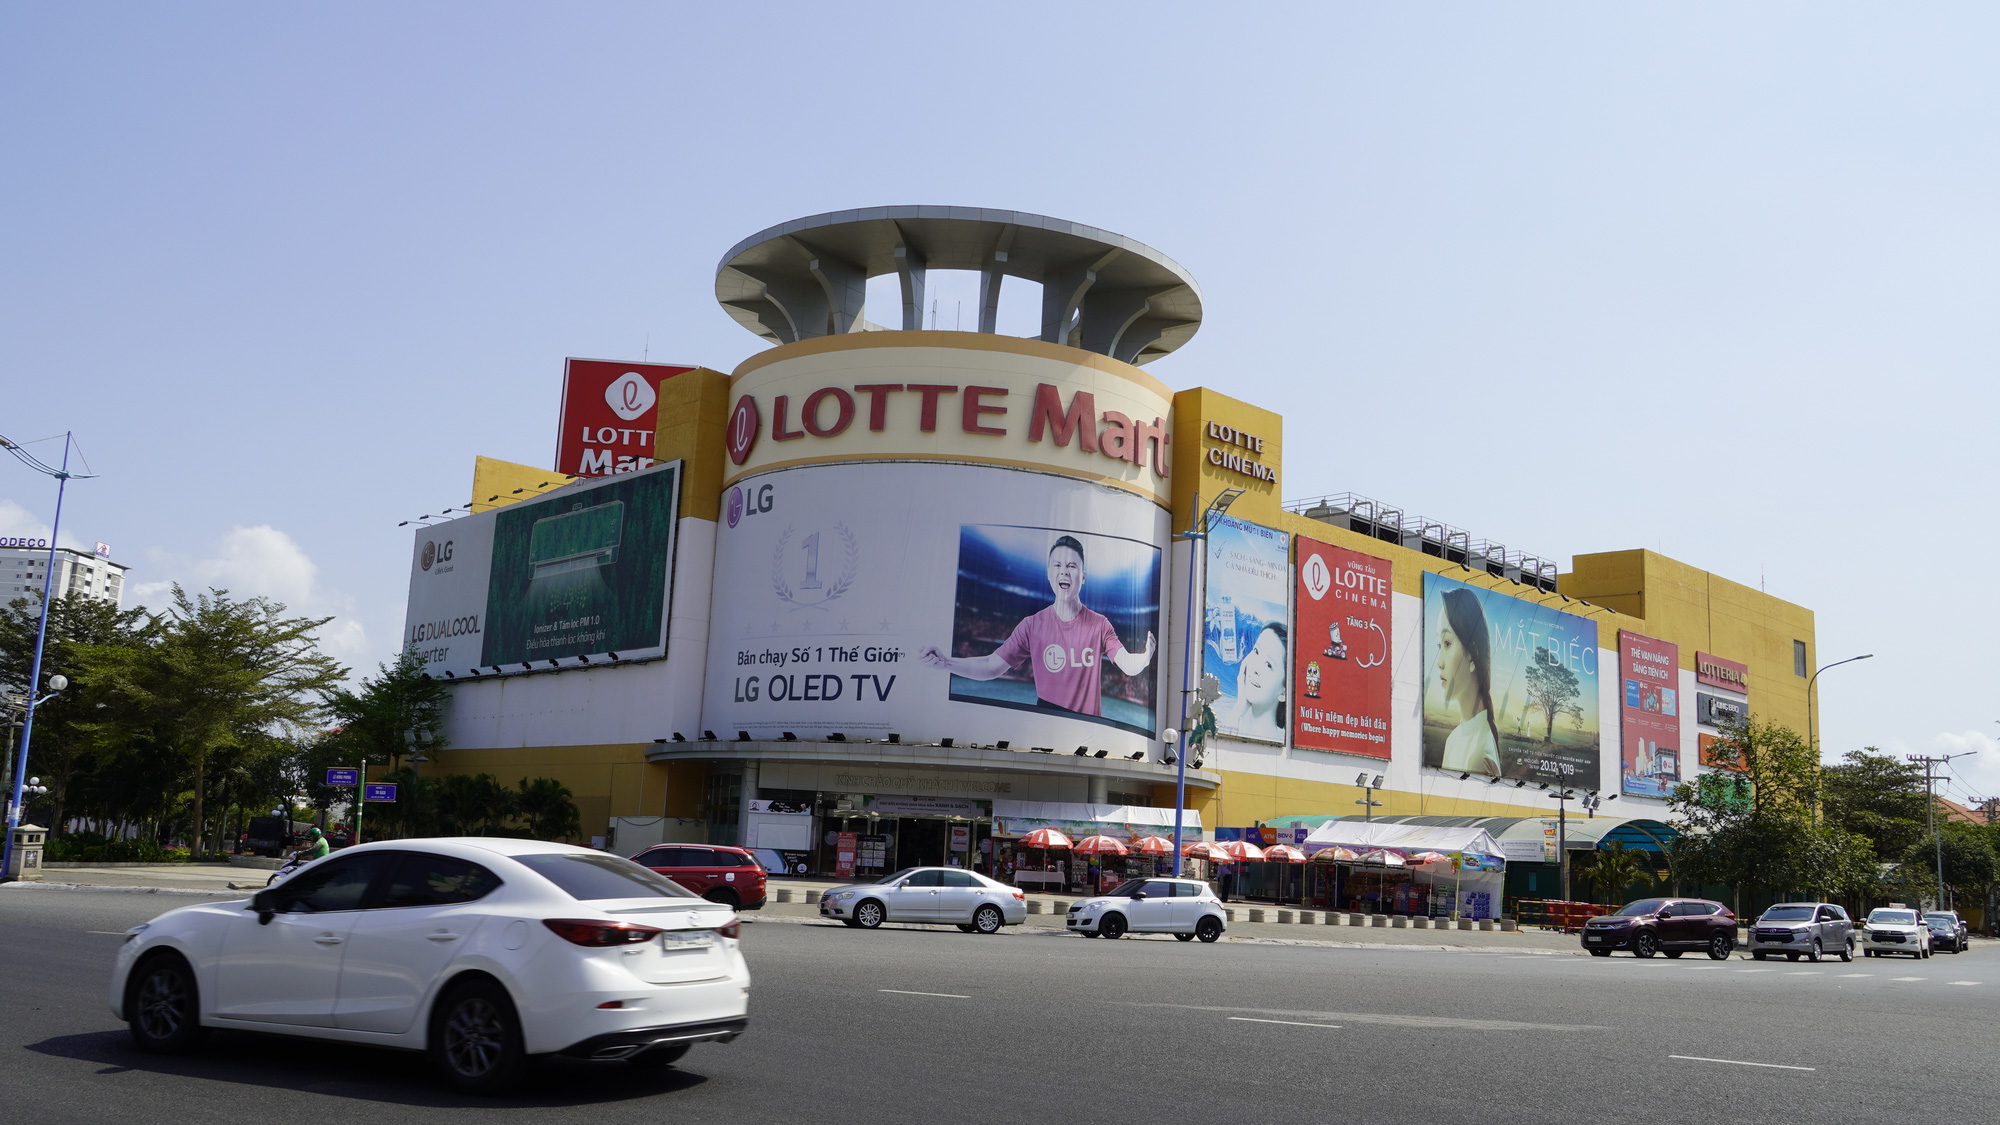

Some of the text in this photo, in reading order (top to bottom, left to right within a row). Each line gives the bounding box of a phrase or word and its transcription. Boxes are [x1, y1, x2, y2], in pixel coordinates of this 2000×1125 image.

[582, 426, 657, 446] LOTT
[772, 382, 1170, 479] LOTTE Mart
[1208, 420, 1265, 454] LOTTE
[579, 448, 654, 475] Mar
[1207, 447, 1278, 484] CINEMA
[745, 484, 774, 516] LG
[436, 540, 453, 563] LG
[1347, 560, 1376, 575] VŨNG TÀU
[1335, 567, 1387, 596] LOTTE
[1335, 588, 1387, 610] CINEMA
[411, 623, 425, 643] LG
[533, 623, 552, 634] Ionizer
[553, 621, 558, 631] &
[580, 616, 590, 627] PM
[1346, 614, 1369, 629] TẦNG 3
[737, 650, 756, 666] Bán
[759, 649, 788, 668] chạy
[791, 646, 811, 663] Số
[815, 647, 823, 663] 1
[828, 645, 859, 663] Thế
[1070, 647, 1094, 668] LG
[1494, 618, 1595, 675] MẮT BIẾC
[1631, 645, 1641, 659] THẺ
[1653, 651, 1670, 666] NĂNG
[1632, 661, 1648, 675] TĂNG
[1699, 660, 1740, 683] LOTTERIA
[734, 674, 897, 702] LG OLED TV
[1300, 705, 1313, 719] Nơi
[1325, 710, 1344, 724] niệm
[1345, 713, 1359, 728] đẹp
[1360, 714, 1372, 728] bắt
[1300, 721, 1386, 744] (Where happy memories begin)
[1540, 759, 1575, 776] 20.122019
[835, 774, 861, 786] KÍNH
[862, 773, 892, 788] CHÀO
[893, 775, 915, 789] QUÝ
[917, 776, 954, 791] KHÁCH
[959, 781, 1012, 793] WELCOME
